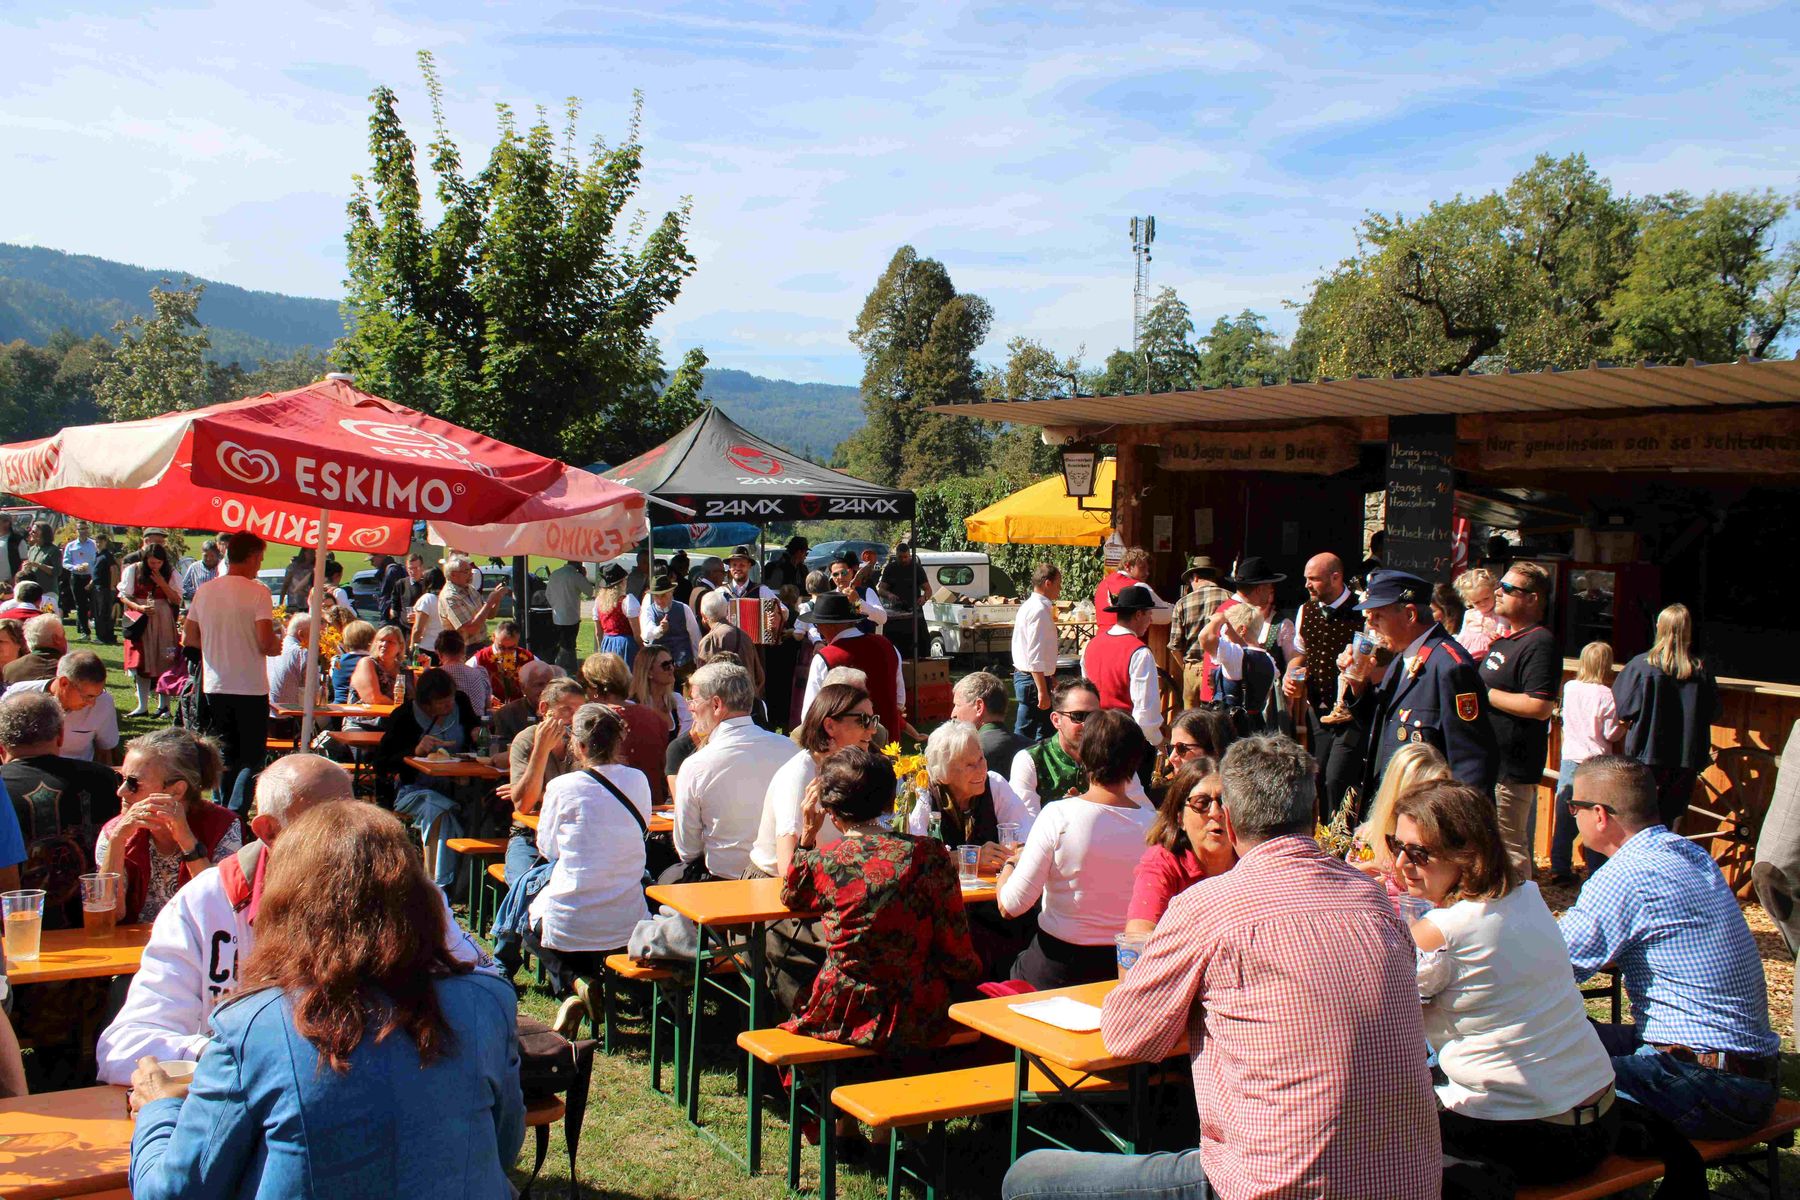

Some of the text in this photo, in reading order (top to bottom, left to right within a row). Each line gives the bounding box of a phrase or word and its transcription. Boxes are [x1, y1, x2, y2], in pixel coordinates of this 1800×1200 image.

[1391, 442, 1420, 461] Honig
[736, 476, 814, 486] 24MX
[705, 498, 784, 517] 24MX
[828, 497, 900, 514] 24MX
